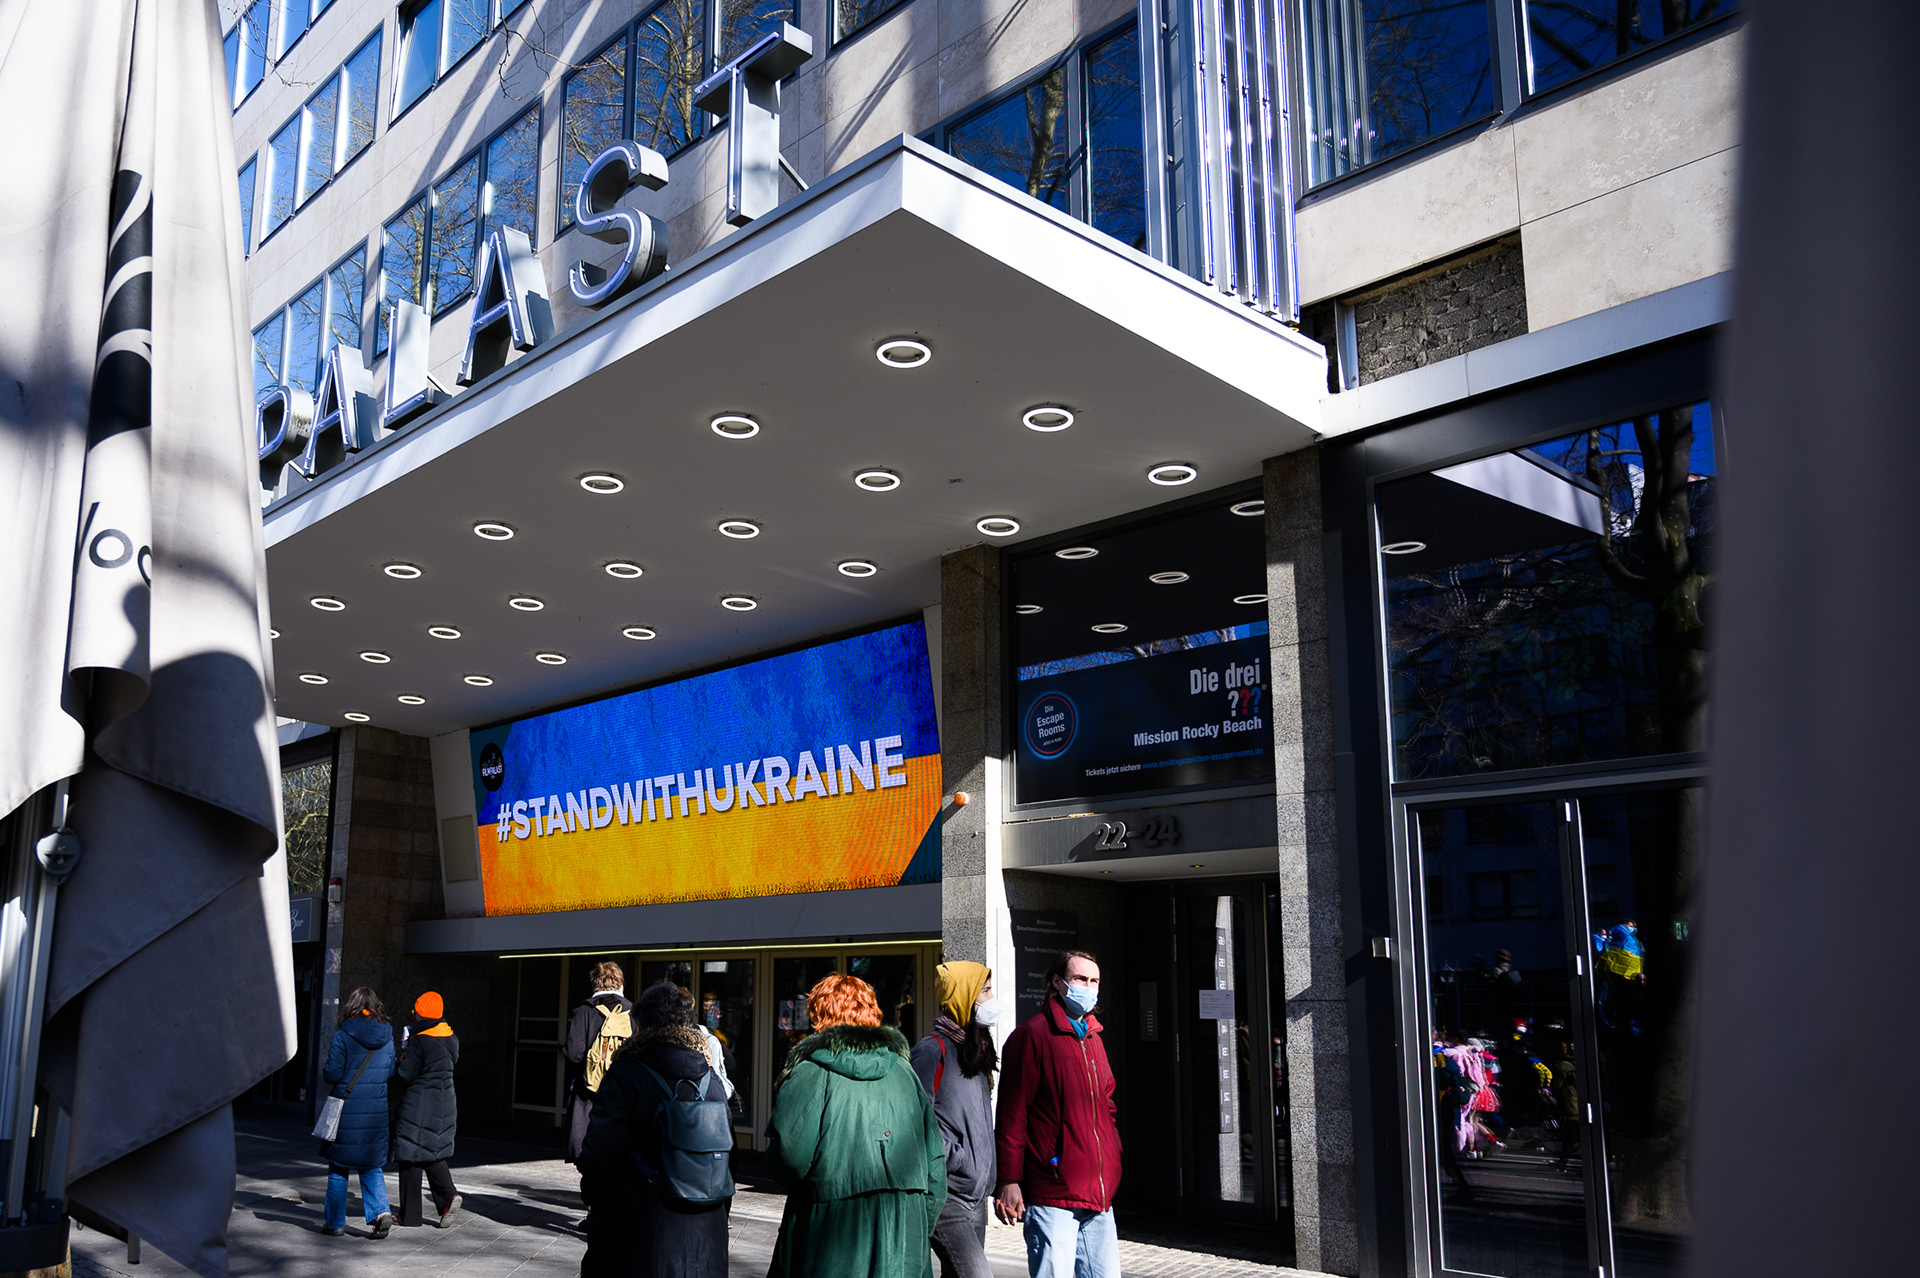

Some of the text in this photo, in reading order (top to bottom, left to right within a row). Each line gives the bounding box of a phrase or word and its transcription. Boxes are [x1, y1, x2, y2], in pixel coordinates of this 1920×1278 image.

[256, 21, 813, 482] PALAST
[1190, 658, 1260, 695] Die drei
[1036, 712, 1065, 728] Escape
[1044, 705, 1054, 714] Die
[1038, 723, 1066, 739] Rooms
[1133, 716, 1262, 747] Mission Rocky Beach
[1085, 747, 1264, 777] Tickets jetzt sichern www.dreifragezeichen-escaperooms.de
[497, 735, 907, 842] #STANDWITHUKRAINE
[1094, 816, 1178, 851] 22-24
